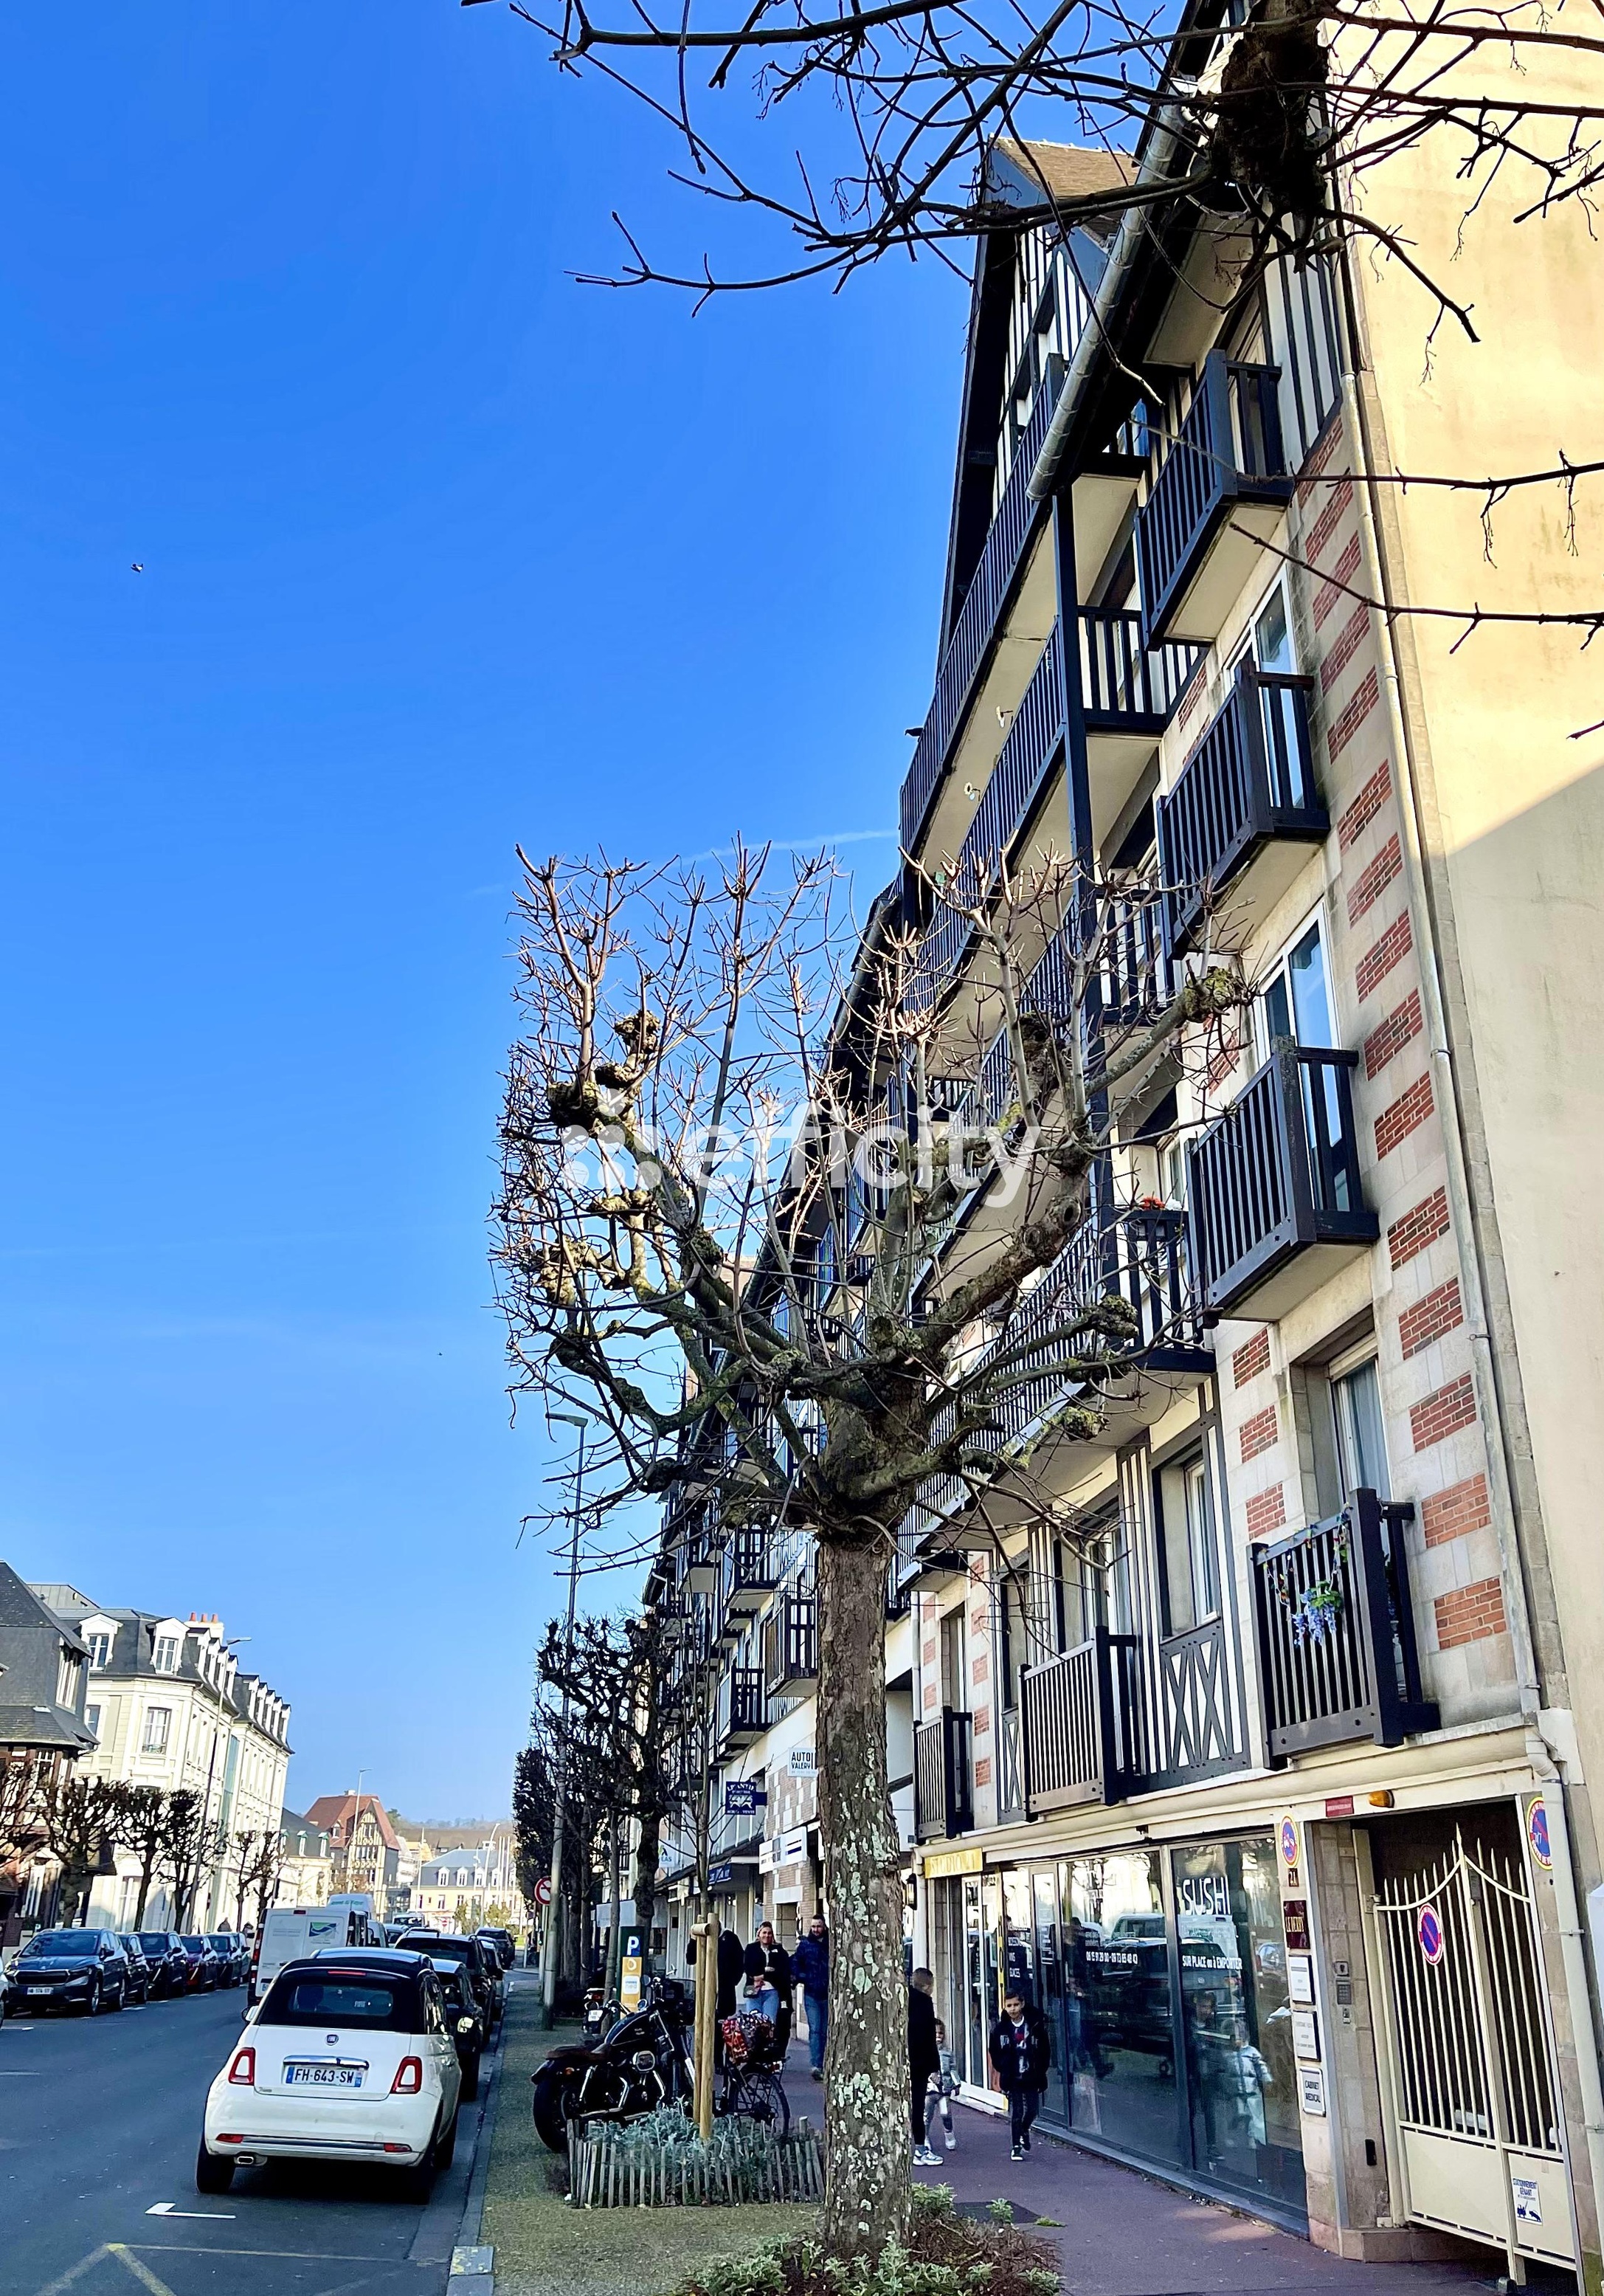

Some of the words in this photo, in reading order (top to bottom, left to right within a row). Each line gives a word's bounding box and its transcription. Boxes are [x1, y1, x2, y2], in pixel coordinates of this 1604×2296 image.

[791, 1751, 810, 1762] AUTO
[1182, 1875, 1231, 1916] SUSHI
[626, 1935, 640, 1956] P
[1192, 1956, 1207, 1968] PLACE
[1216, 1957, 1242, 1971] EMPORTER
[294, 2068, 355, 2083] FH-643-SW
